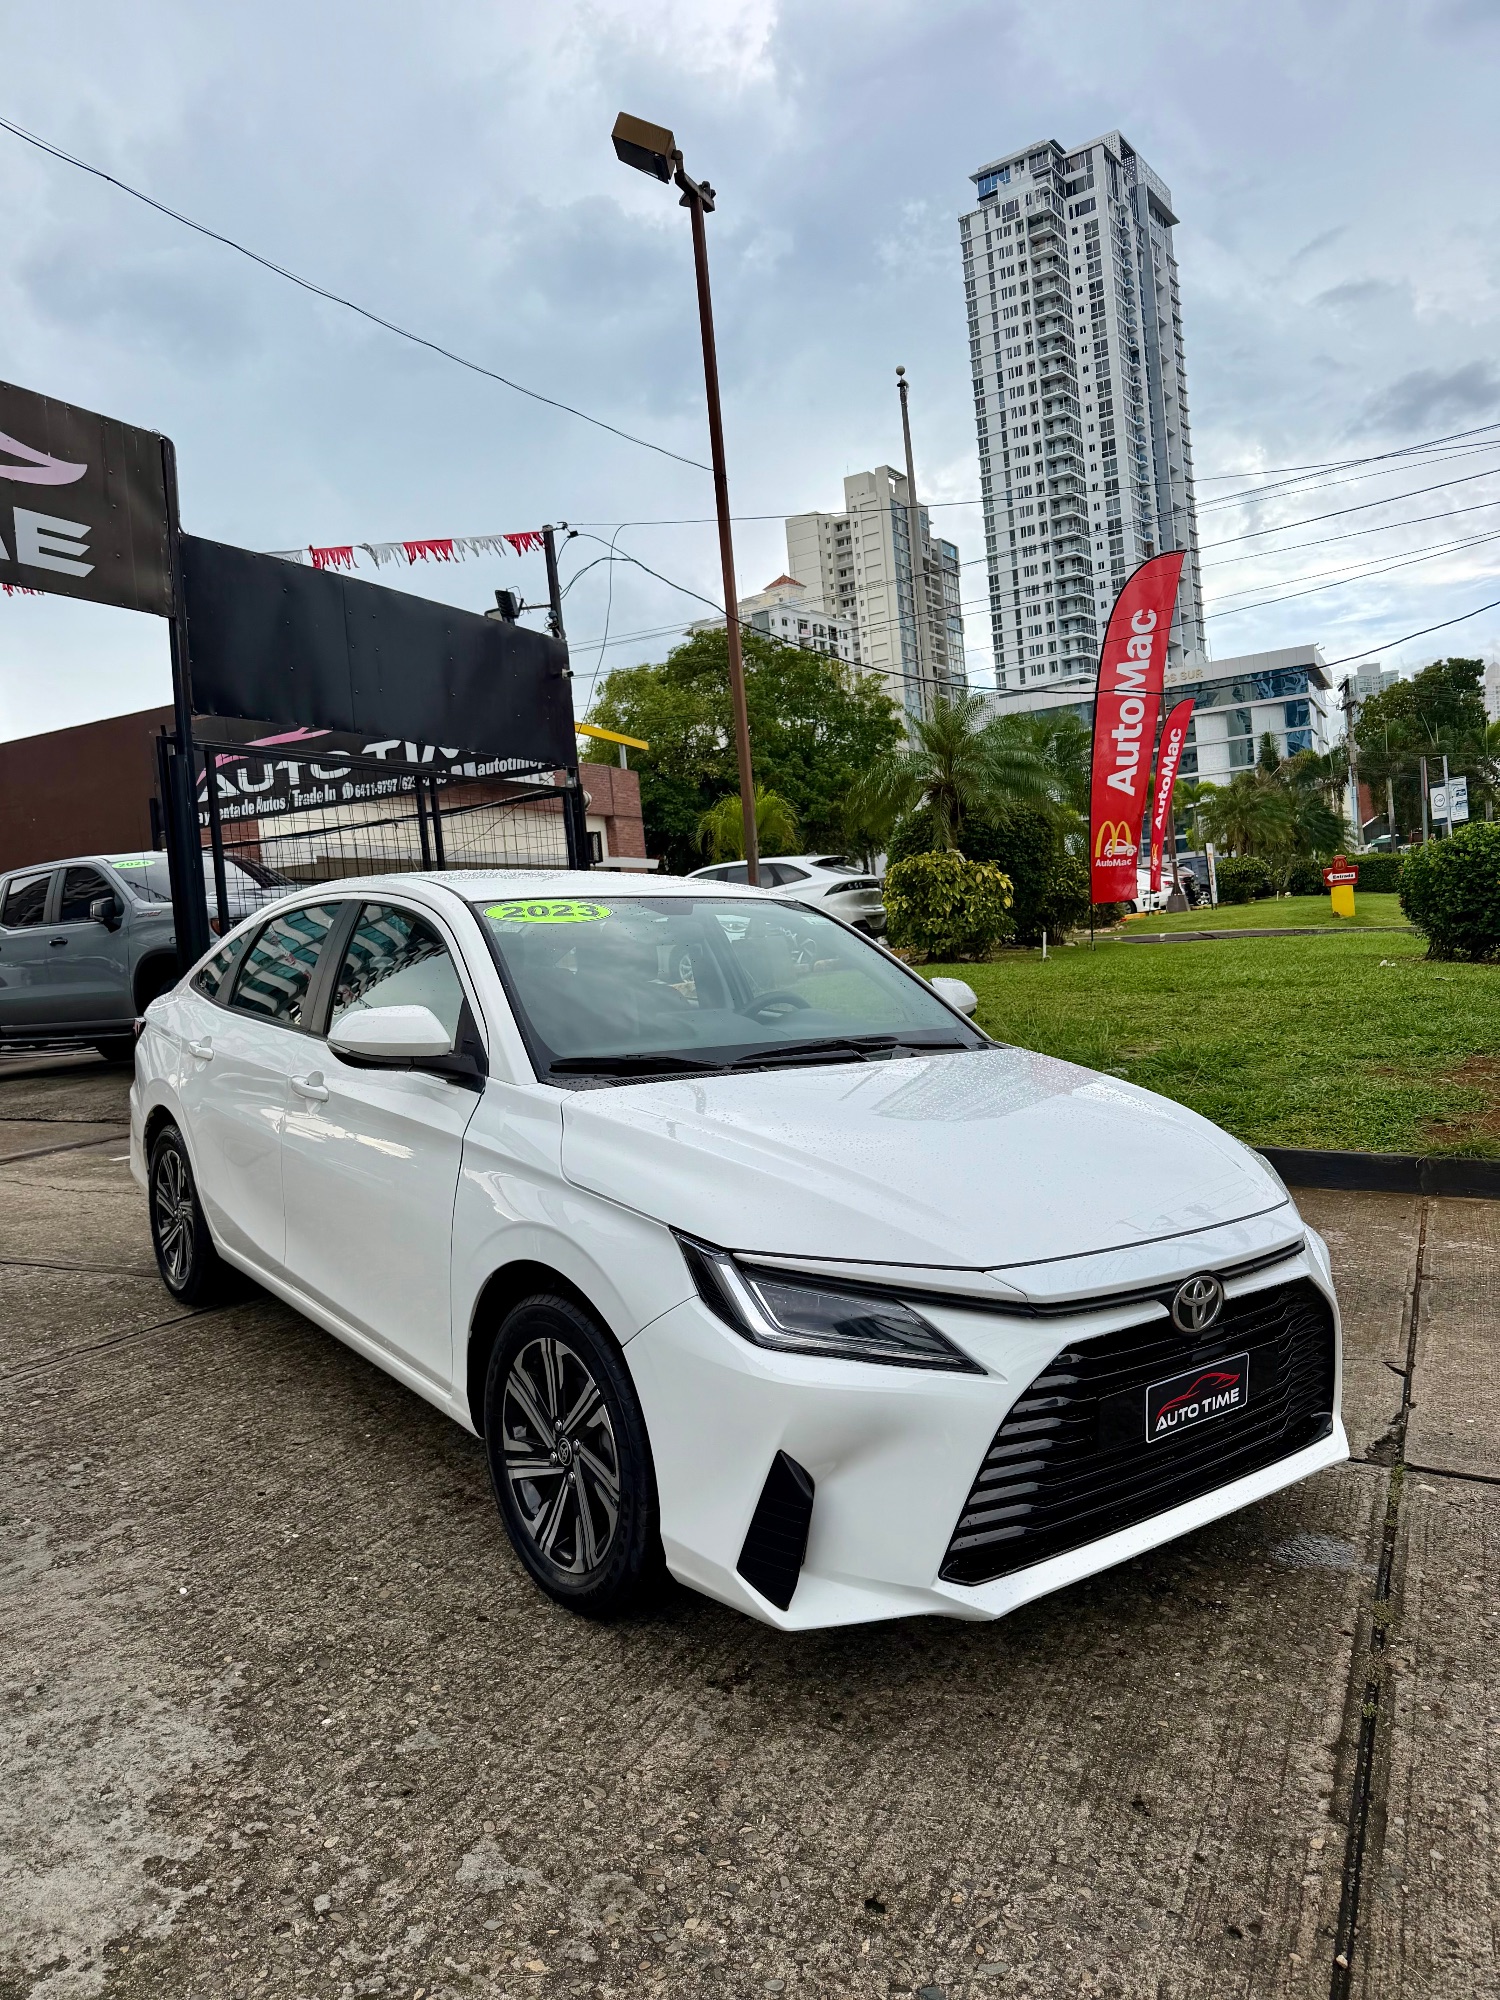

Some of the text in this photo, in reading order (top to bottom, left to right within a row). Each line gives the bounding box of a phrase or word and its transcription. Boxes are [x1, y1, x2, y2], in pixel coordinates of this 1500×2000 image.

[0, 506, 96, 578] E
[1163, 669, 1204, 683] OS SUR
[1106, 608, 1157, 797] AutoMac
[1154, 727, 1182, 830] AutoMac
[241, 798, 255, 815] de
[256, 796, 286, 813] Autos
[291, 786, 324, 807] Trade
[1095, 858, 1132, 867] AutoMac
[501, 904, 600, 918] 2023
[1155, 1387, 1240, 1432] AUTO TIME
